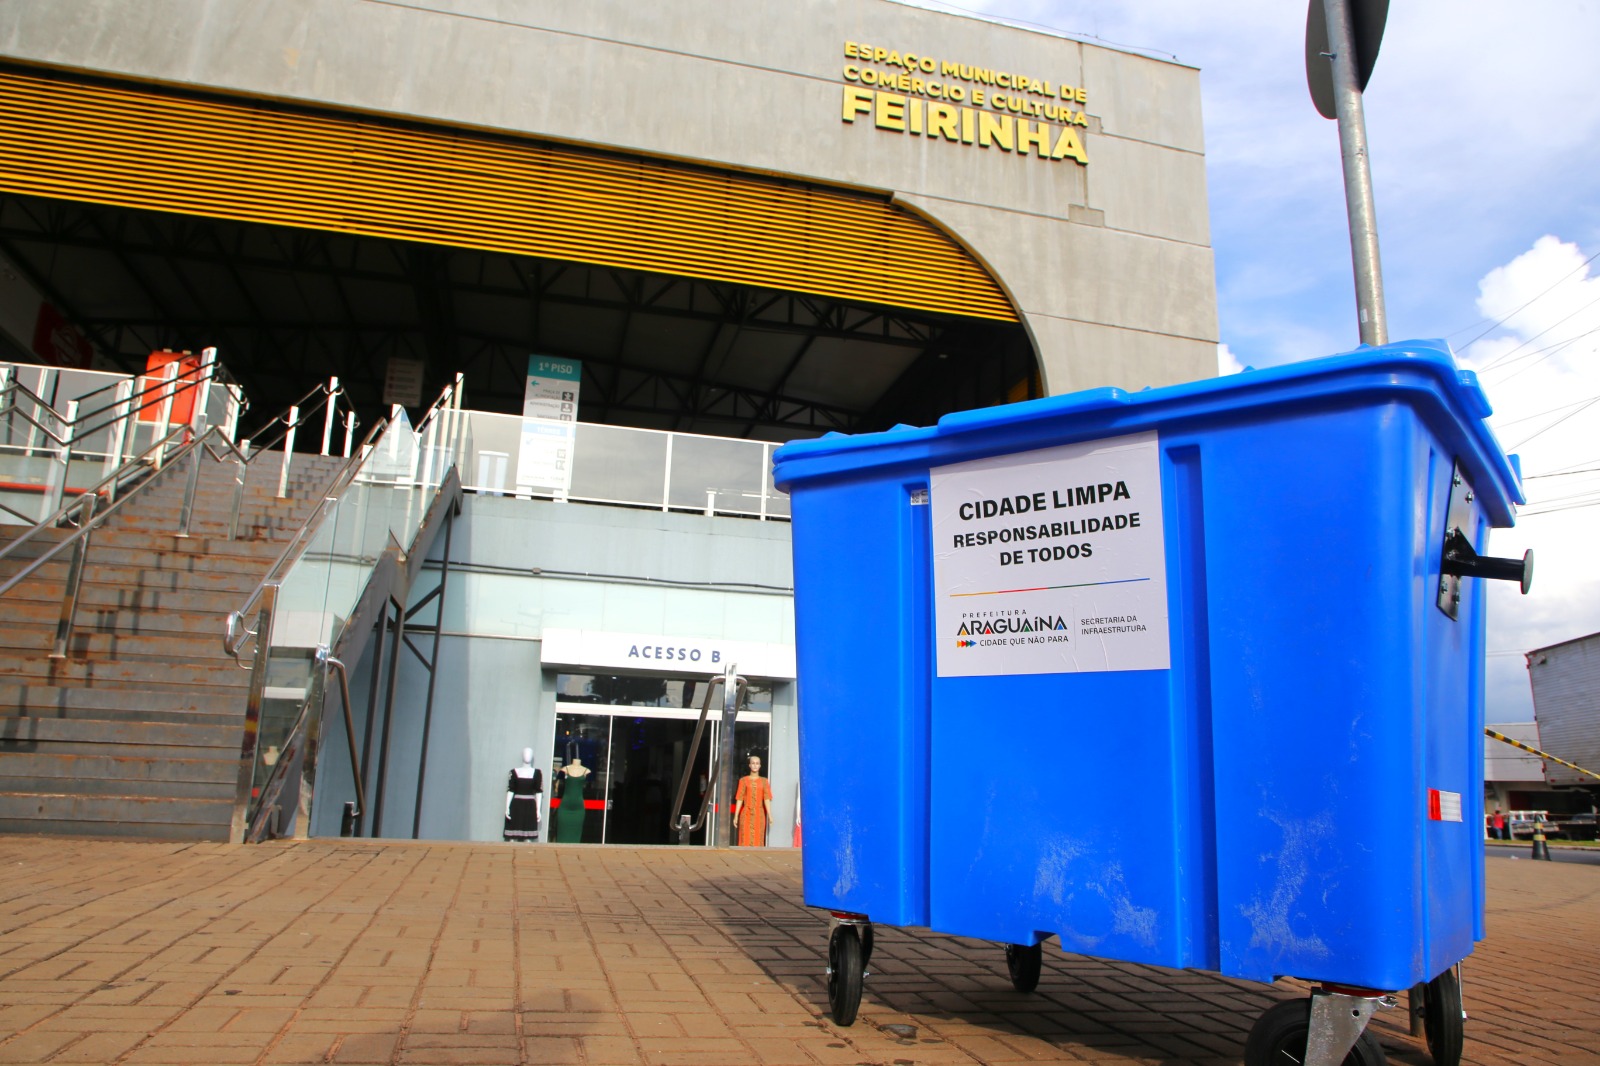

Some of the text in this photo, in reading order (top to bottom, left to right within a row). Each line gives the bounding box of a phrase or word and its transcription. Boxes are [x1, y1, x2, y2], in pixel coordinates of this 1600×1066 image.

[844, 41, 1087, 104] ESPAÇO MUNICIPAL DE
[843, 65, 1088, 127] COMÉRCIO E CULTURA
[842, 85, 1088, 166] FEIRINHA
[551, 364, 572, 374] PISO
[959, 492, 1046, 521] CIDADE
[1053, 480, 1131, 509] LIMPA
[953, 512, 1141, 548] RESPONSABILIDADE
[1000, 543, 1093, 566] DE TODOS
[962, 609, 1027, 618] PREFEITURA
[1081, 615, 1138, 626] SECRETARIA DA
[1081, 624, 1146, 635] INFRAESTRUTURA
[980, 635, 1069, 647] CIDADE QUE NÃO PARA
[628, 645, 721, 663] ACESSO B
